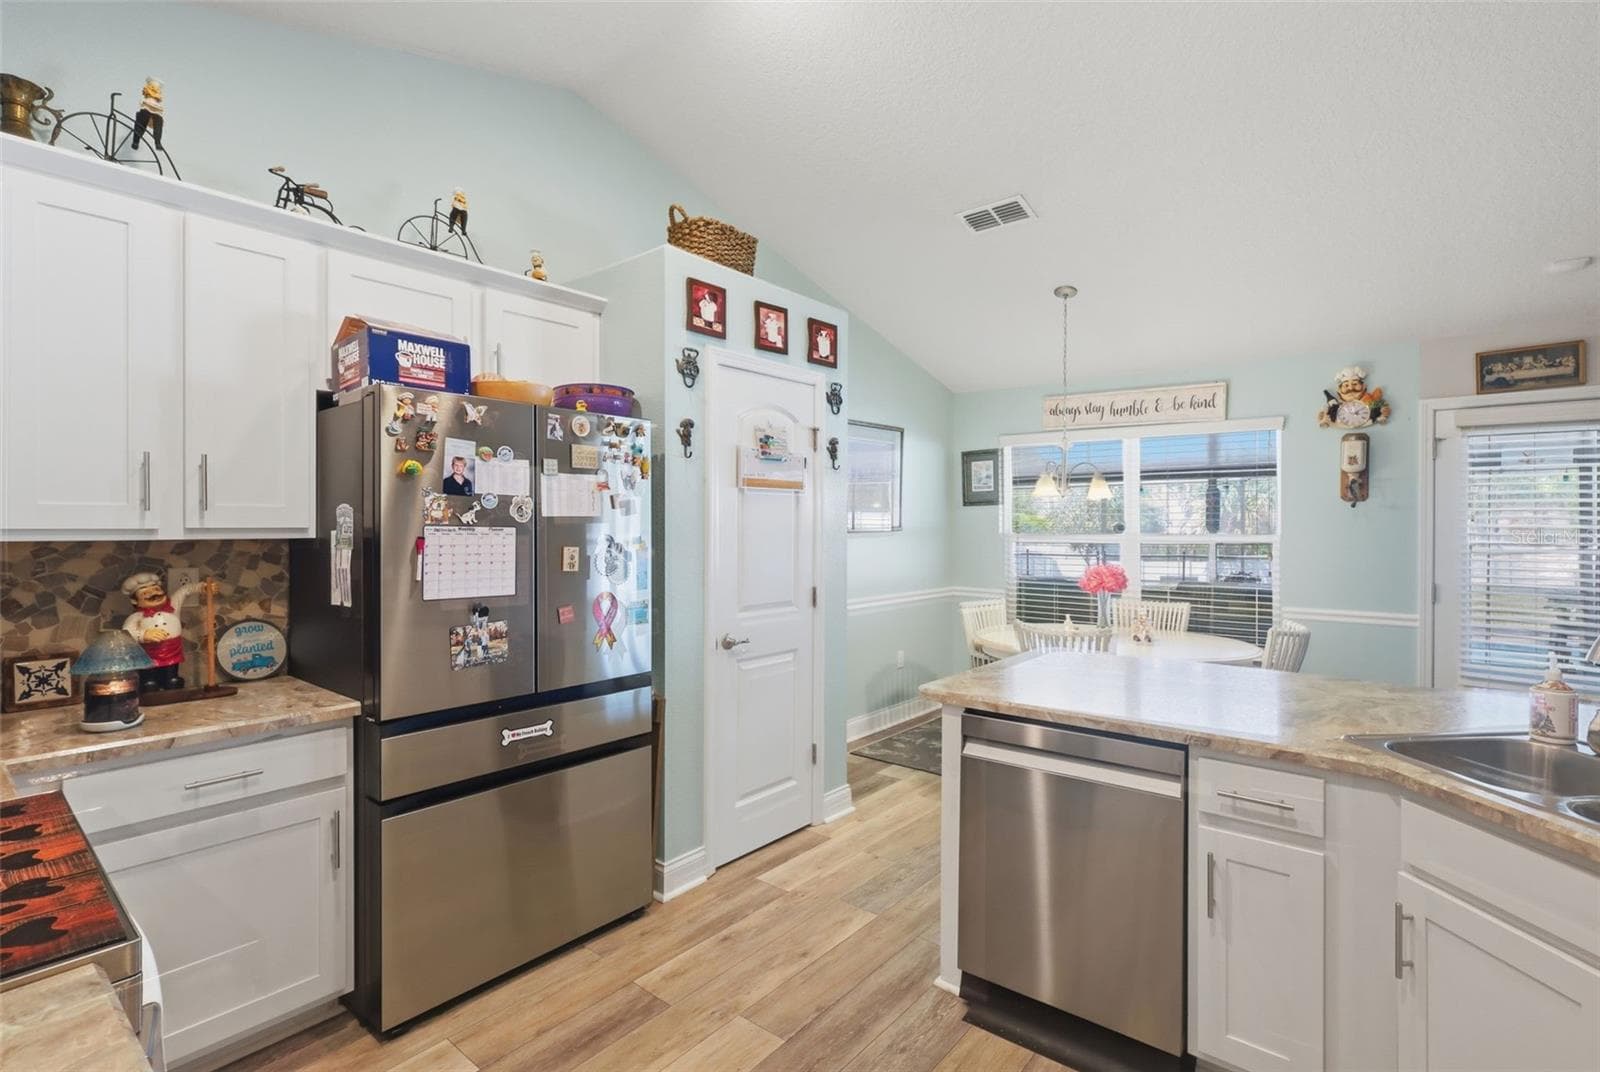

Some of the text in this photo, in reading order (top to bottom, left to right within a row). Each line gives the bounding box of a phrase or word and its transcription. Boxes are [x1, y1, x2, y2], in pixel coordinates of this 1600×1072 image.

[397, 339, 446, 358] MAXWELL
[413, 353, 446, 369] HOUSE
[1049, 391, 1218, 422] always stay humble & be kind
[234, 624, 264, 637] grow
[229, 640, 274, 657] planted
